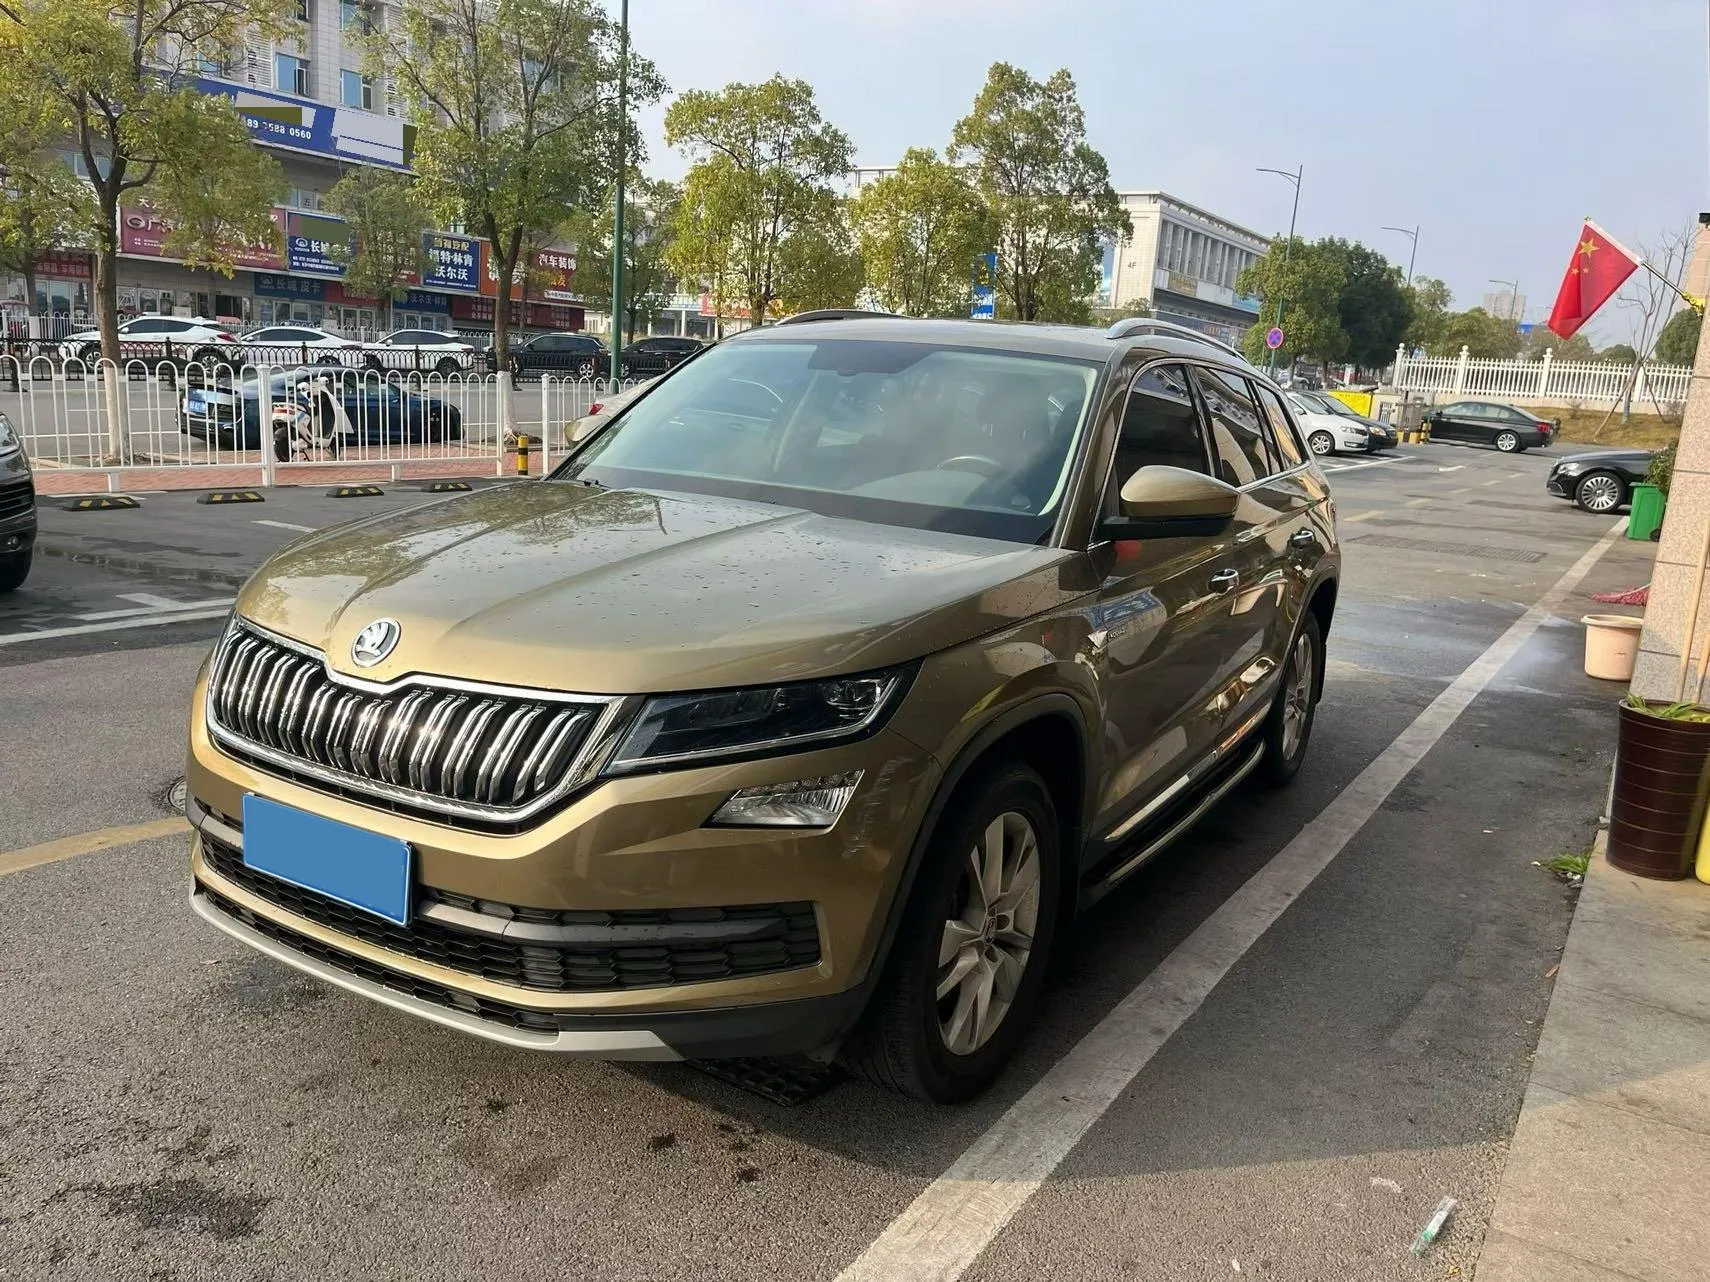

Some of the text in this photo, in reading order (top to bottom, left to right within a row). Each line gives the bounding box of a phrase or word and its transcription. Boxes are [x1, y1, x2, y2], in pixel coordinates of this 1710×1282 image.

[289, 127, 311, 139] 0560
[538, 253, 577, 271] 汽车装饰
[1128, 261, 1137, 270] 4F
[435, 265, 468, 281] 沃尔沃
